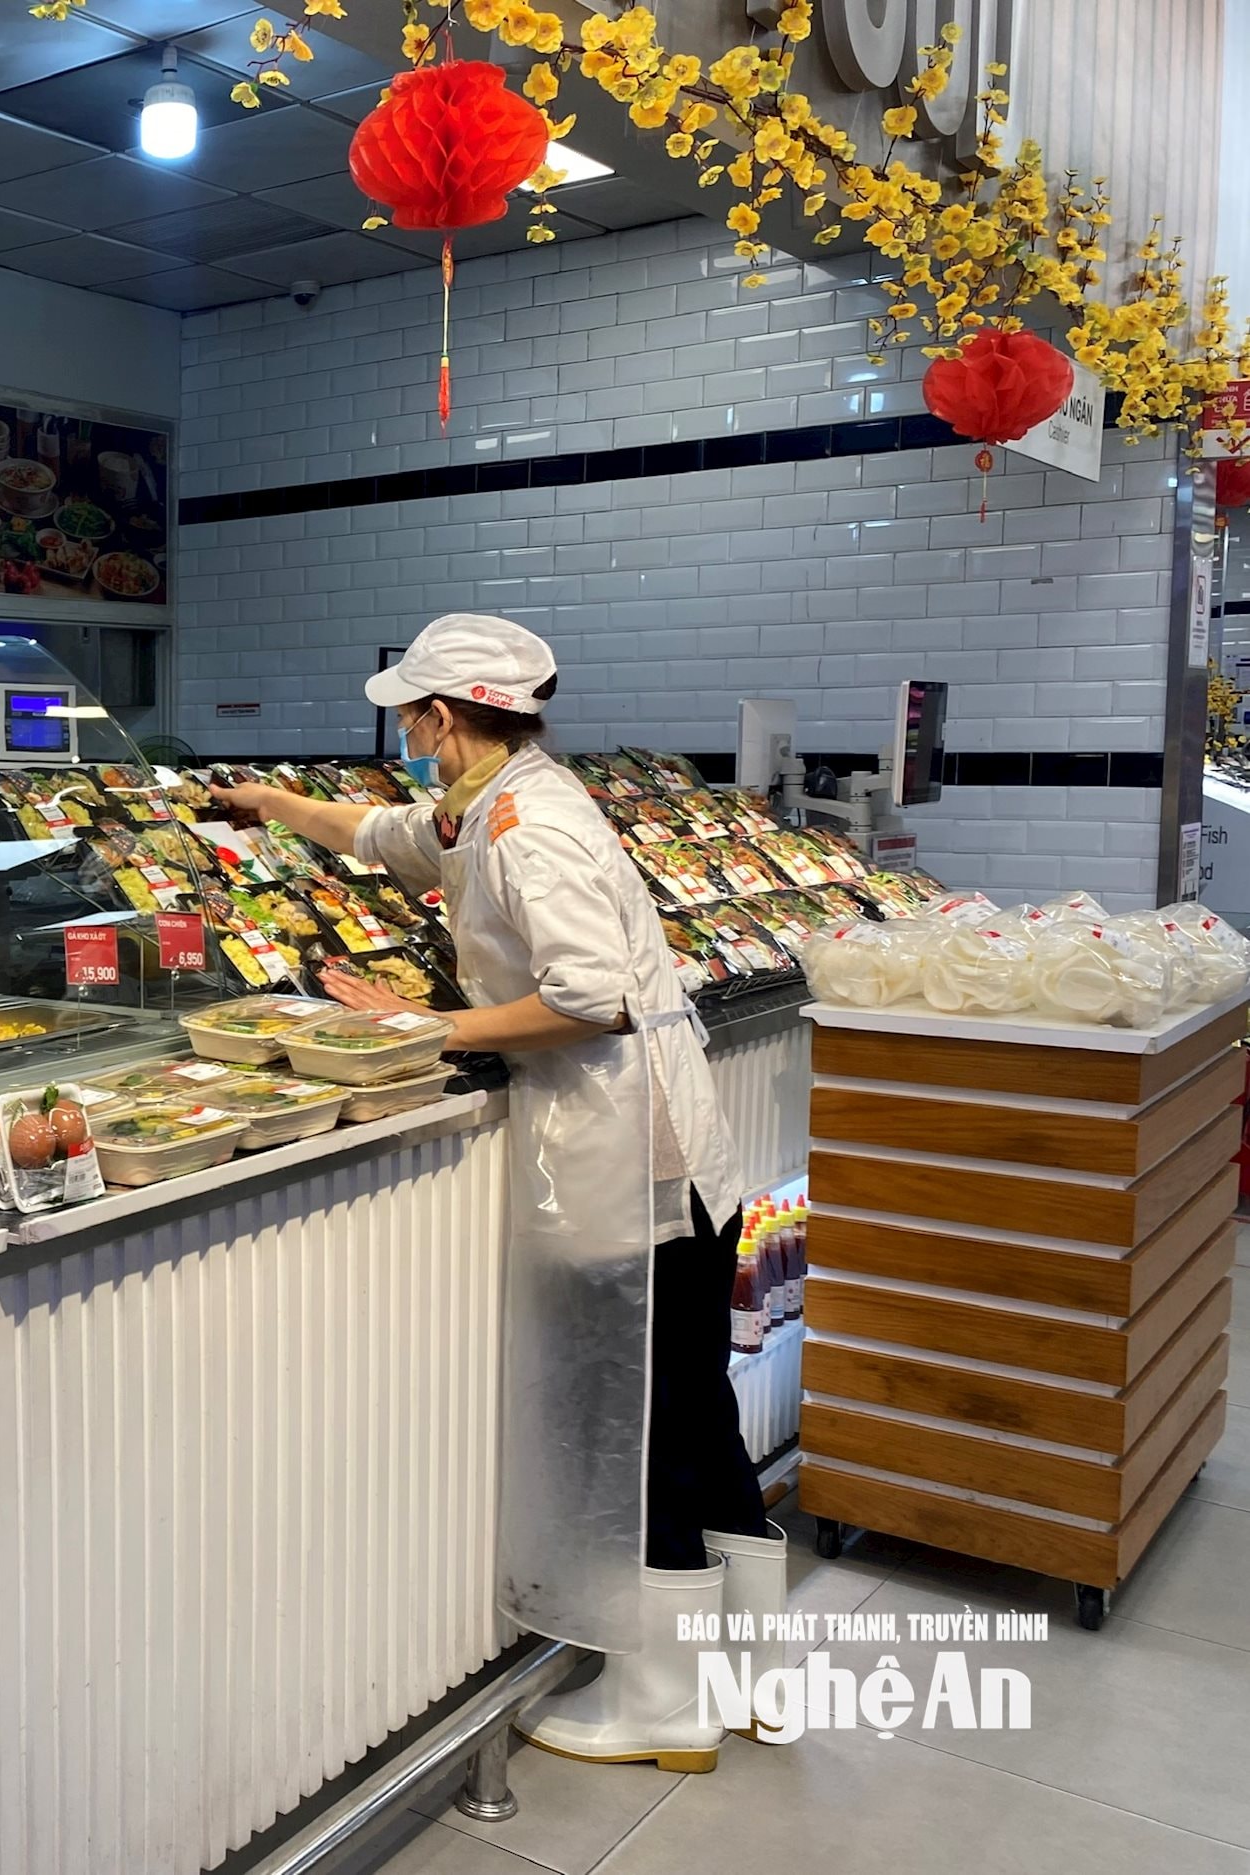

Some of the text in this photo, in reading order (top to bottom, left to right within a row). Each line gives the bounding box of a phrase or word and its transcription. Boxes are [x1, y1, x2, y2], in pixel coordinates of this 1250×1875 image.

[1069, 395, 1093, 427] NGÂN
[486, 696, 511, 709] MART
[1201, 825, 1228, 844] Fish
[178, 952, 203, 967] 6,950
[82, 966, 116, 982] 15,900
